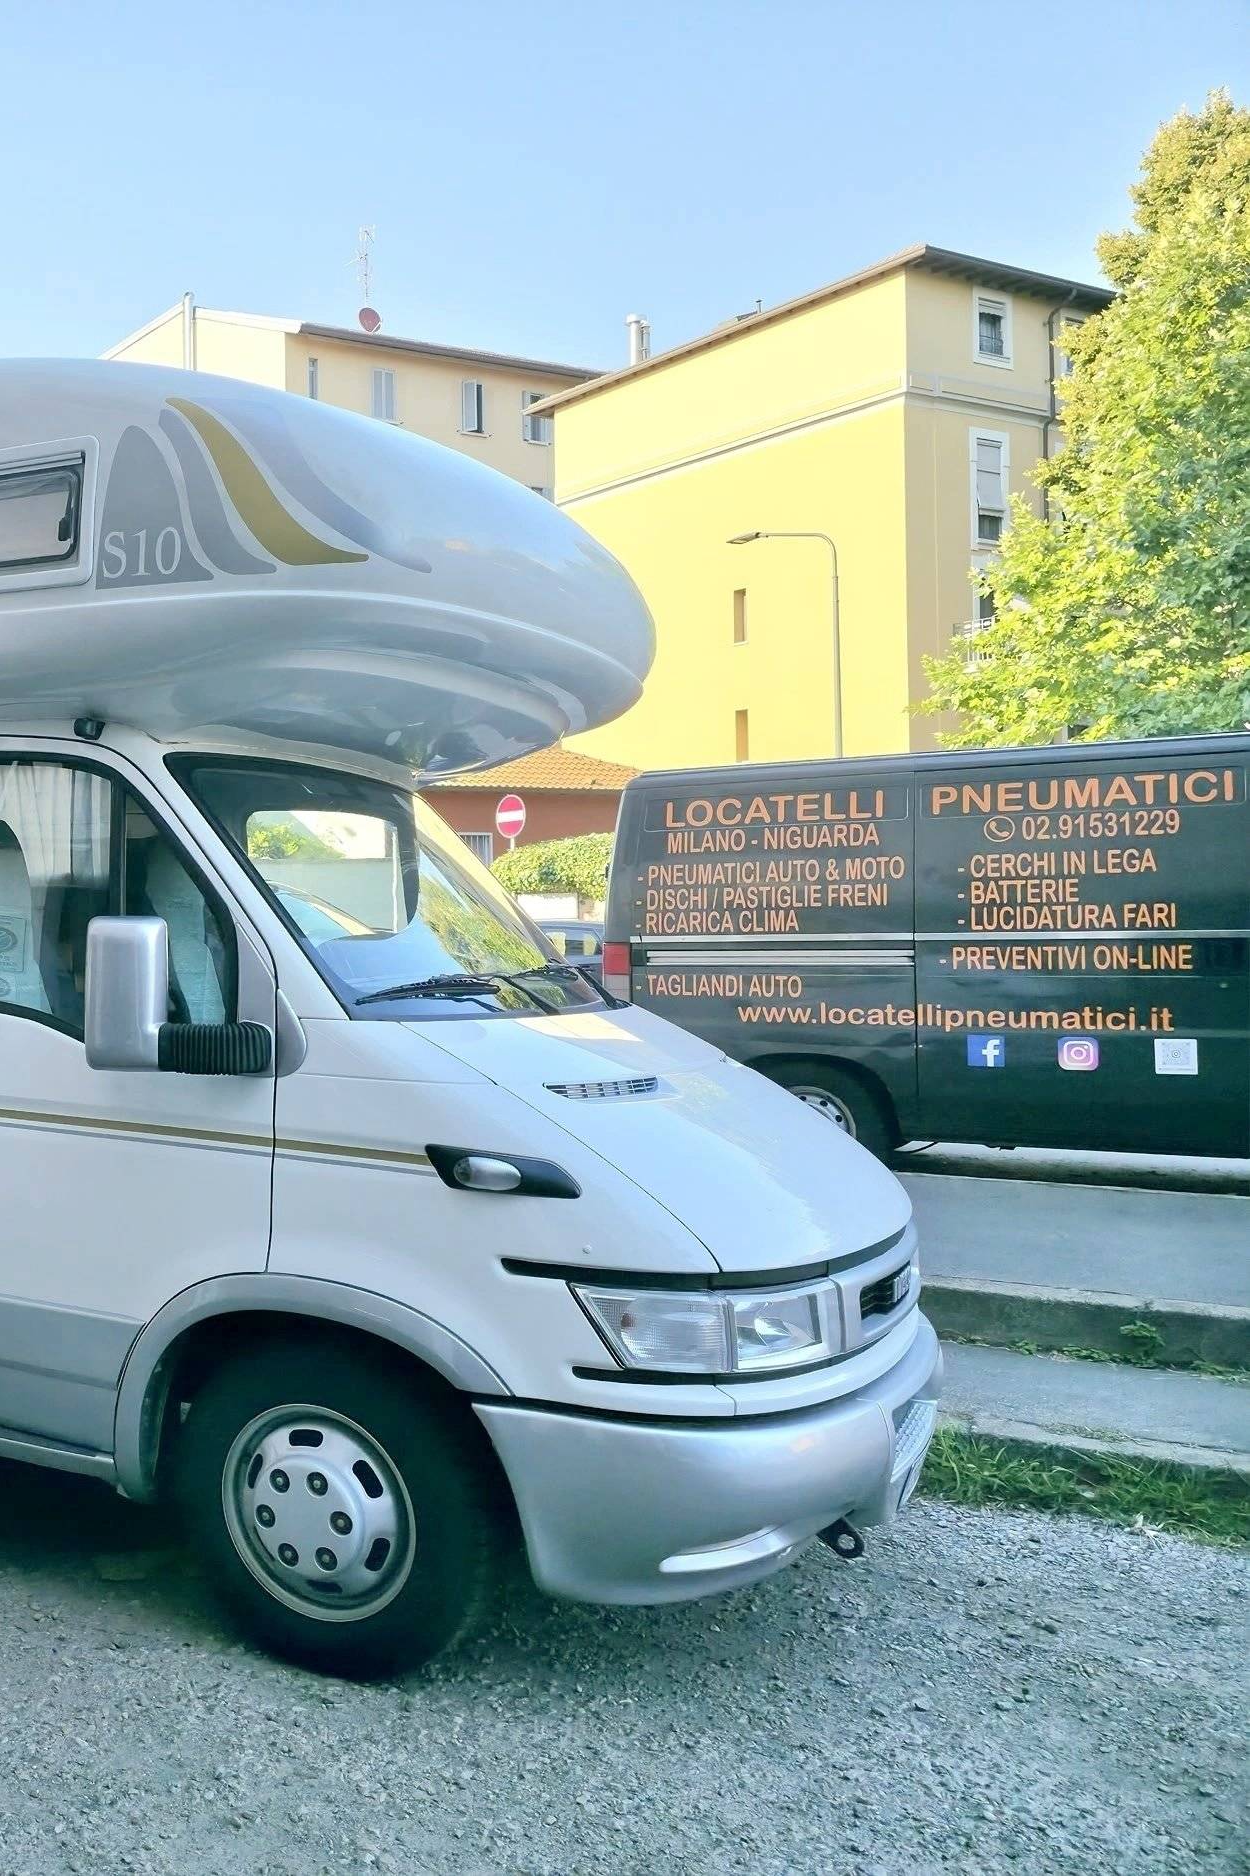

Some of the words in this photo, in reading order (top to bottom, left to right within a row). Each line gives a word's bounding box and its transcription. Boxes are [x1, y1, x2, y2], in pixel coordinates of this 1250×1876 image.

[103, 527, 181, 578] S10
[666, 790, 884, 828] LOCATELLI
[932, 770, 1234, 815] PNEUMATICI
[667, 829, 746, 854] MILANO
[763, 823, 880, 850] NIGUARDA
[1021, 808, 1180, 840] 02.91531229
[648, 862, 760, 886] PNEUMATICI
[766, 859, 820, 882] AUTO
[825, 858, 840, 881] &
[845, 856, 905, 880] MOTO
[970, 852, 1055, 878] CERCHI
[1063, 851, 1086, 875] IN
[1093, 848, 1157, 874] LEGA
[646, 888, 707, 910] DISCHI
[723, 885, 822, 909] PASTIGLIE
[828, 884, 888, 907] FRENI
[970, 879, 1080, 904] BATTERIE
[646, 911, 734, 933] RICARICA
[739, 909, 799, 932] CLIMA
[970, 903, 1117, 930] LUCIDATURA
[1123, 903, 1176, 928] FARI
[952, 945, 1086, 969] PREVENTIVI
[1093, 944, 1193, 969] ON-LINE
[647, 974, 743, 996] TAGLIANDI
[749, 975, 802, 998] AUTO
[738, 1002, 1175, 1031] www.locatellipneumatici.it
